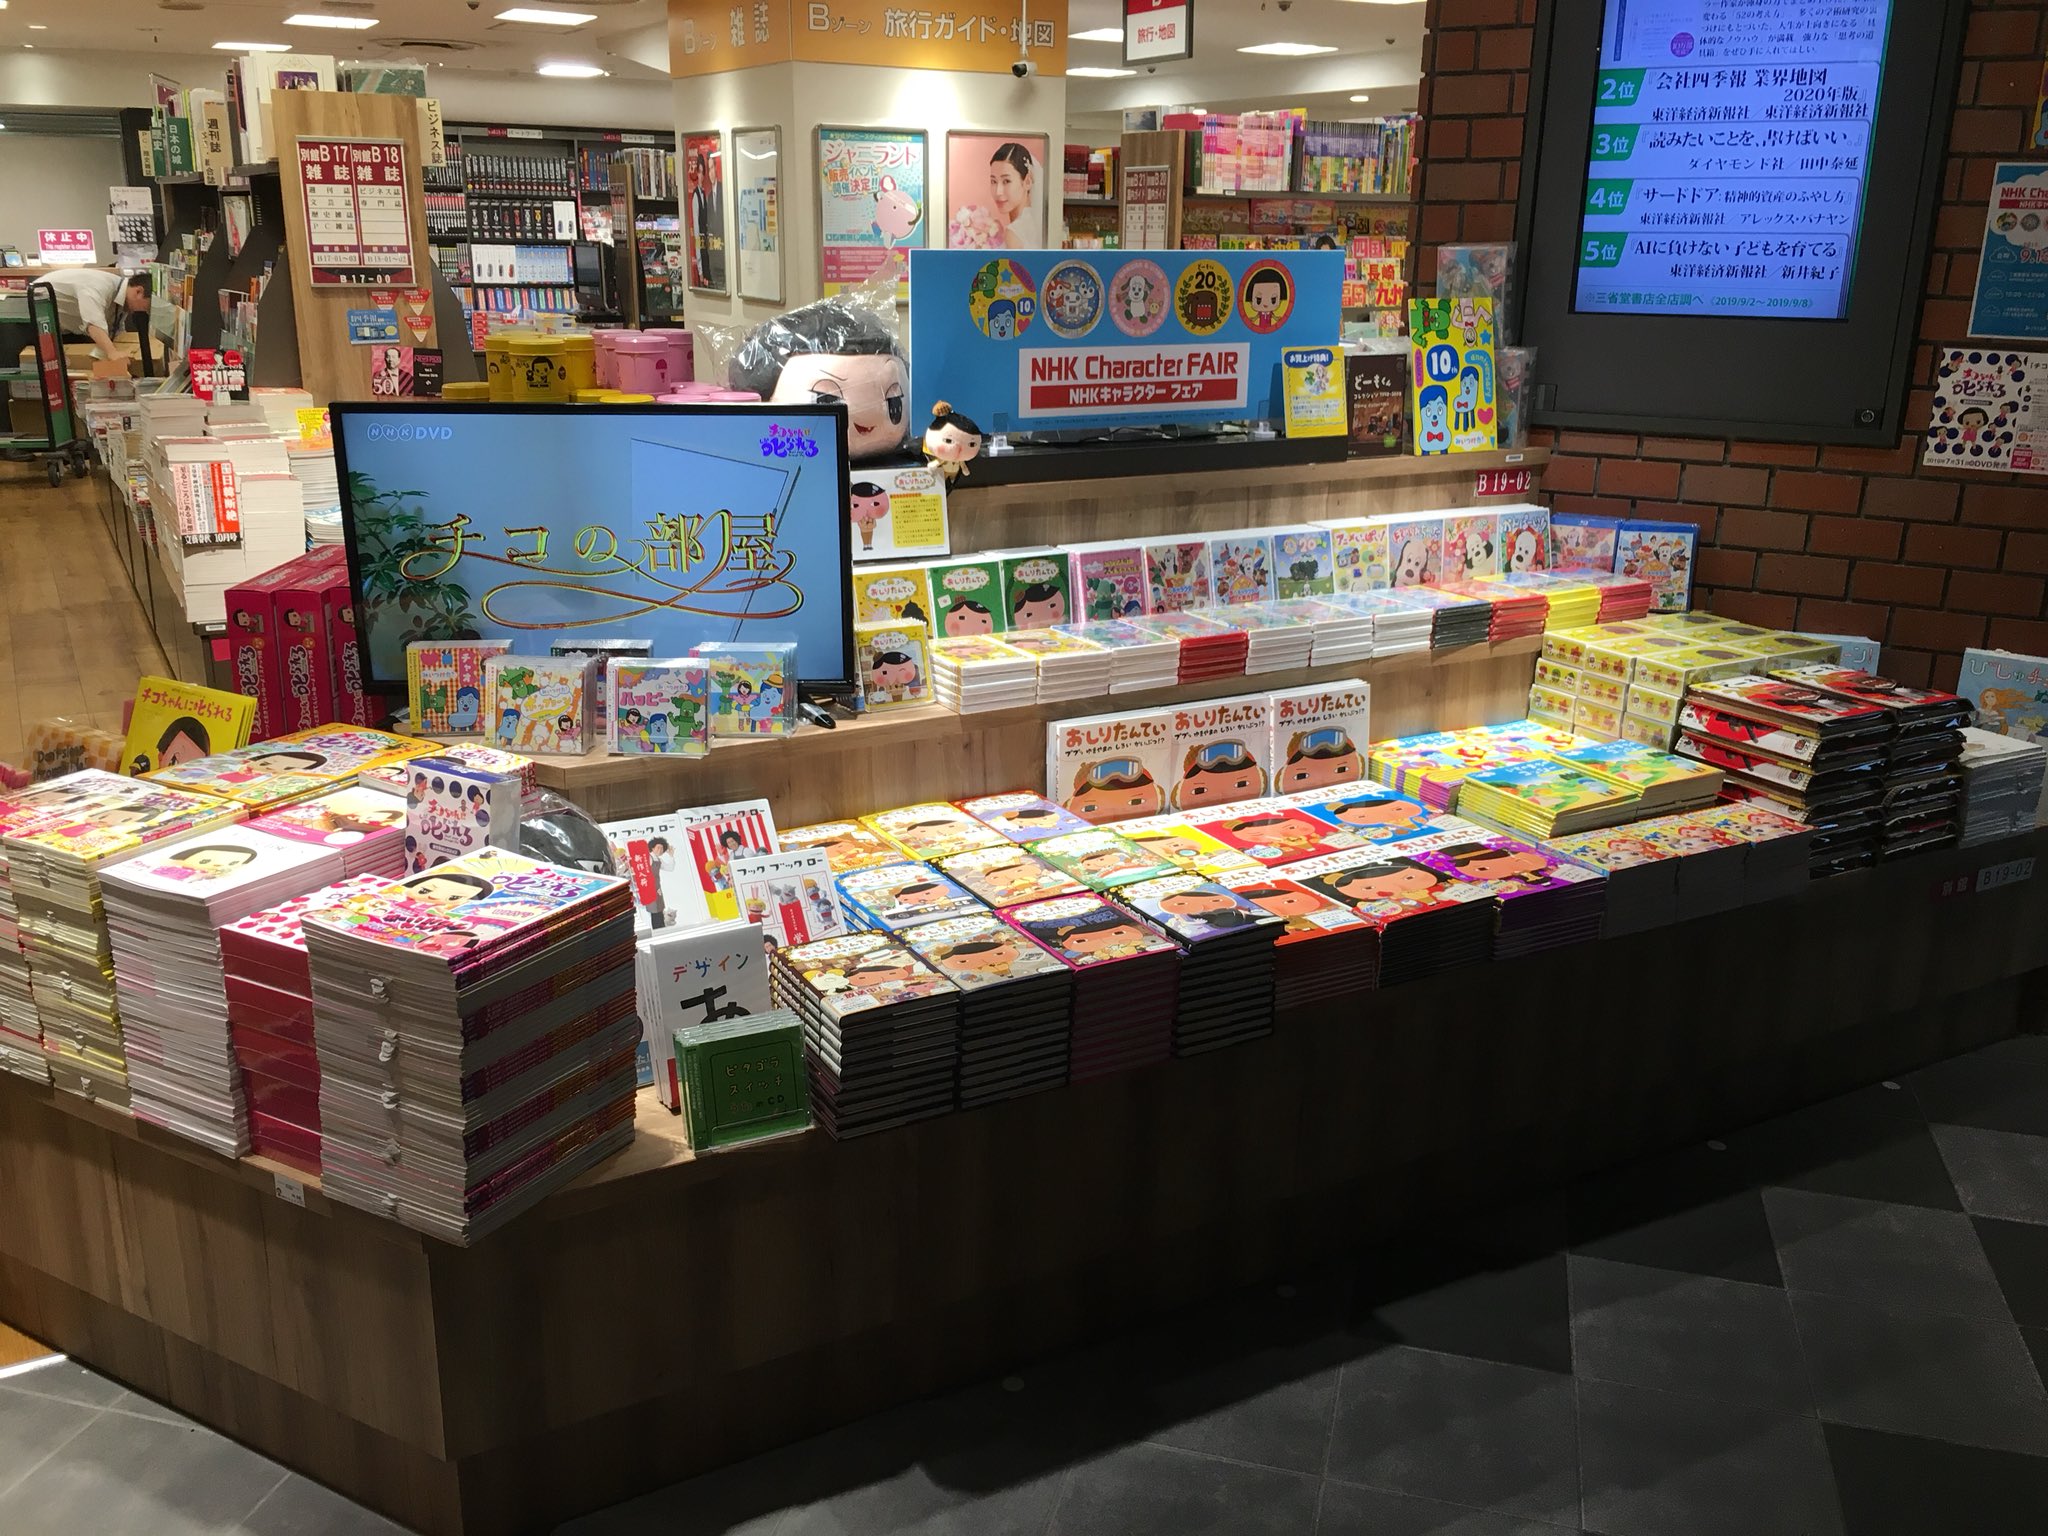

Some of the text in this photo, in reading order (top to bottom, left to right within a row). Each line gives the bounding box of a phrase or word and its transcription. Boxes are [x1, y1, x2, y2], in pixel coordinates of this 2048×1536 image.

[729, 2, 769, 47] 雑誌
[808, 3, 871, 35] Bゾーン
[1136, 22, 1176, 44] 旅行・地図
[1754, 67, 1828, 86] 業界地図
[1600, 78, 1635, 100] 2位
[207, 118, 222, 153] 週刊誌
[426, 100, 444, 165] ビジネス誌
[169, 124, 183, 165] 日本の城
[1595, 133, 1629, 155] 3位
[305, 163, 351, 181] 雑誌
[356, 165, 401, 182] 雑誌
[358, 187, 402, 197] ビジネス誌
[1589, 187, 1624, 209] 4位
[2001, 187, 2027, 199] NHK
[44, 231, 89, 243] 休止中
[1583, 240, 1618, 262] 5位
[1194, 271, 1216, 290] 20
[1367, 263, 1396, 281] 長崎
[1374, 281, 1404, 306] 九州
[193, 369, 246, 385] 芥川賞
[1031, 351, 1239, 382] NHK Character FAIR
[1354, 373, 1392, 391] どーもくん
[1068, 382, 1203, 406] NHKキャラクター フェア
[367, 422, 453, 442] NHK DVD
[1492, 470, 1533, 493] 19-02
[405, 511, 790, 578] チコの部屋
[946, 574, 988, 586] おしりたんてい
[1016, 567, 1057, 579] おしりたんてい
[869, 584, 914, 597] おしりたんてい
[872, 636, 908, 646] おしりたんてい
[460, 652, 473, 684] チャオ
[619, 691, 671, 707] ハッピー
[1279, 692, 1367, 718] おしりたんてい
[1174, 704, 1267, 731] おしりたんてい
[1065, 721, 1168, 748] おしりたんてい
[684, 808, 765, 824] フック ブック ロー
[621, 826, 655, 838] ブック
[659, 824, 676, 832] ロー
[1391, 827, 1487, 851] おしりたんてい
[633, 853, 649, 888] 新作入荷
[736, 857, 824, 876] フック ブック ロー
[1279, 848, 1386, 875] おしりたんてい
[1982, 860, 2032, 888] B19-02
[672, 953, 749, 983] デザイン
[725, 1057, 780, 1077] ピタゴラ
[730, 1075, 784, 1095] スイッチ
